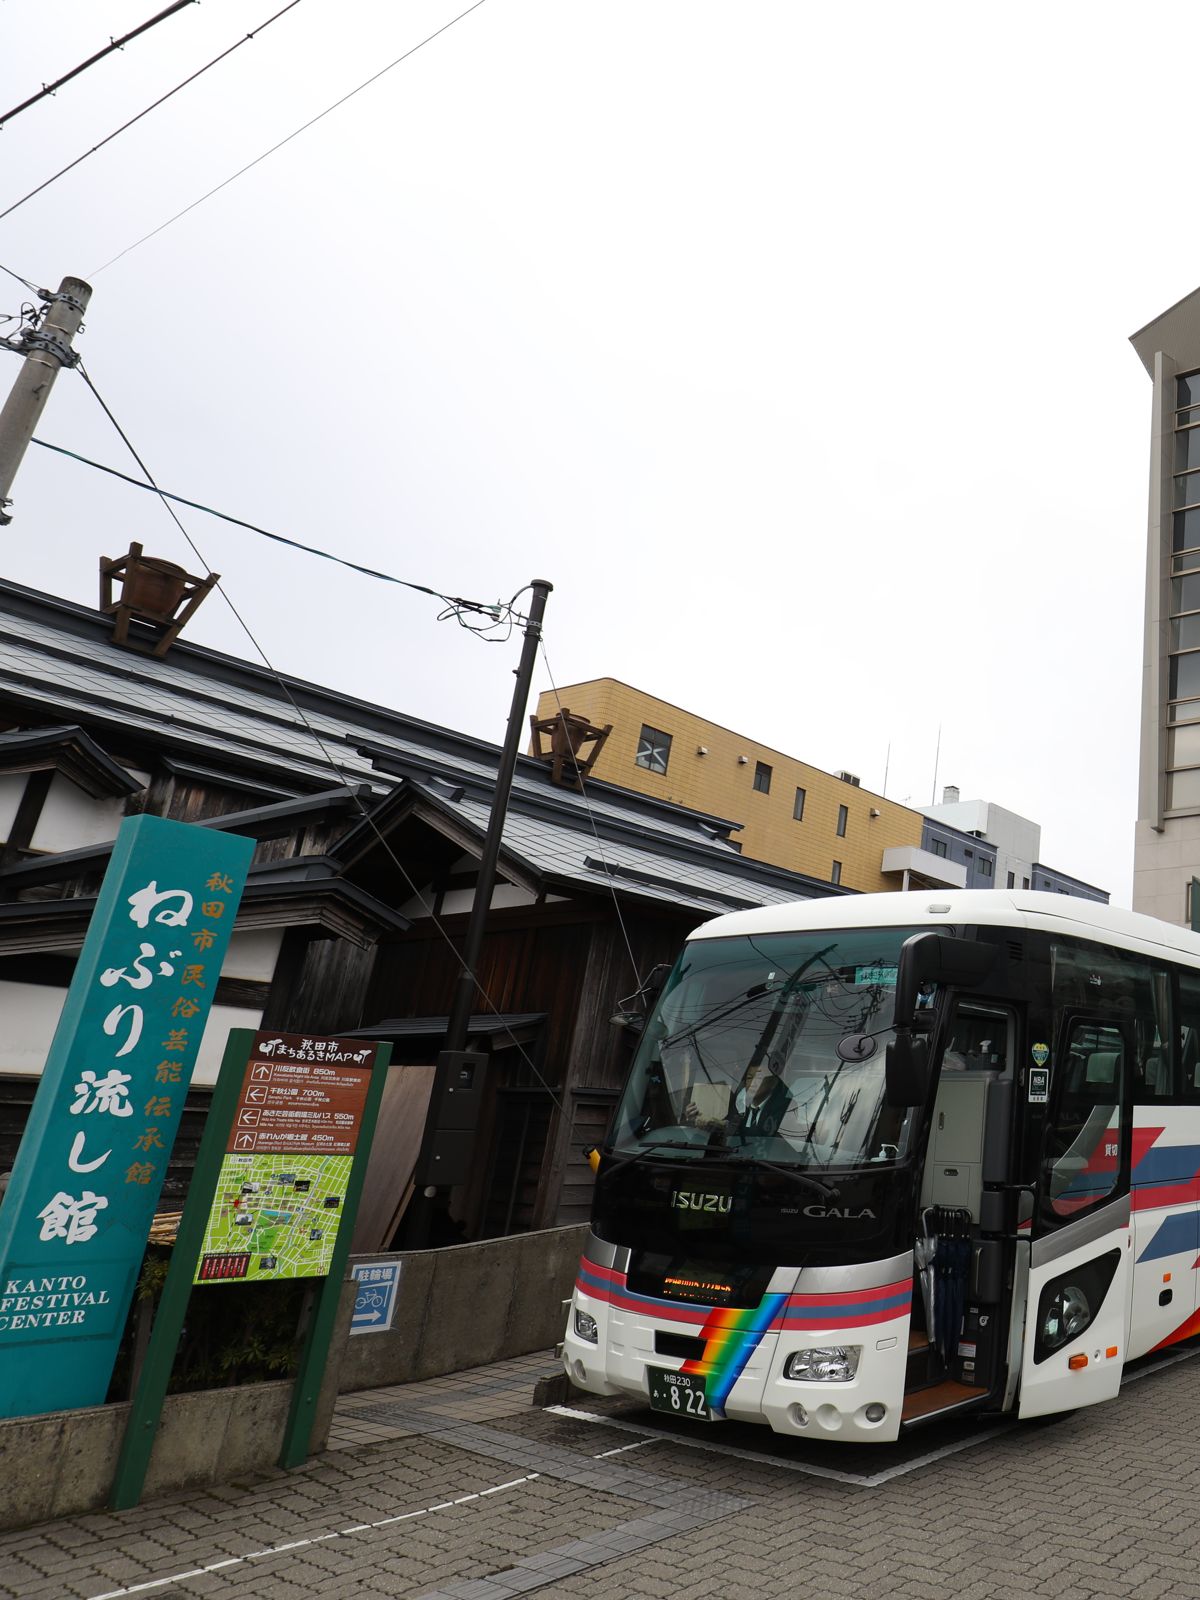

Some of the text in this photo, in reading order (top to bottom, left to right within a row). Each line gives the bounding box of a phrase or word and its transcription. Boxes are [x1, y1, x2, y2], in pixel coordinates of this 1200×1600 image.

[125, 871, 234, 1185] 秋田市民俗芸能伝承館
[276, 1043, 353, 1063] まちあるきMAP
[300, 1038, 340, 1053] 秋田市
[37, 880, 194, 1246] ねぶり流し館
[302, 1089, 325, 1097] 700m
[311, 1134, 335, 1142] 450m
[670, 1190, 733, 1213] ISUZU
[802, 1205, 876, 1219] GALA
[4, 1275, 87, 1295] KANTO
[358, 1268, 393, 1282] 駐輪場
[0, 1290, 110, 1313] FESTIVAL
[0, 1309, 86, 1331] CENTER
[670, 1385, 707, 1416] 822
